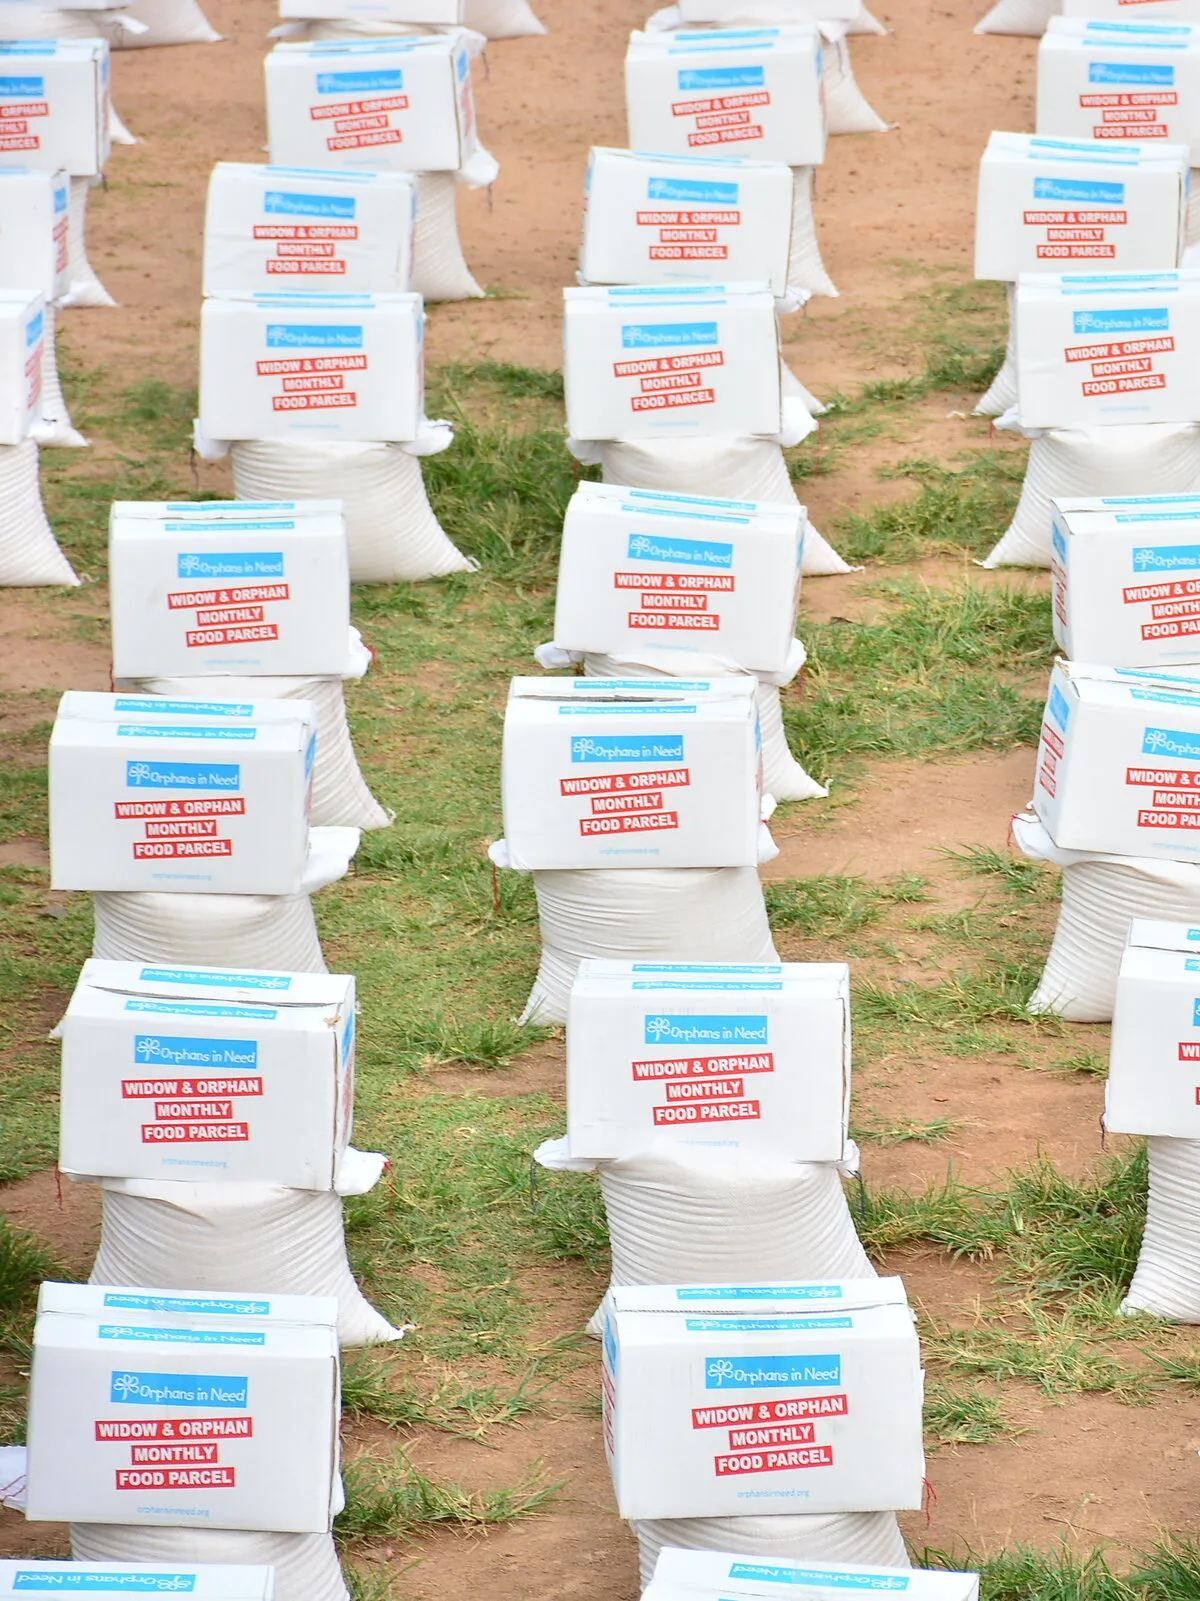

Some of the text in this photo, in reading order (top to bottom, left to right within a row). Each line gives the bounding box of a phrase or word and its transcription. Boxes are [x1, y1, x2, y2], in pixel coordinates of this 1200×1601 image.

[1066, 345, 1109, 360] WIDOW
[1122, 338, 1173, 354] ORPHAN
[258, 360, 301, 374] WIDOW
[315, 356, 365, 371] ORPHAN
[1093, 358, 1150, 376] MONTHLY
[284, 376, 342, 390] MONTHLY
[1083, 375, 1164, 394] FOOD PARCEL
[274, 393, 355, 409] FOOD PARCEL
[617, 574, 732, 590] WIDOW & ORPHAN
[643, 595, 706, 609] MONTHLY
[630, 614, 718, 628] FOOD PARCEL
[594, 745, 683, 761] Orphans in Need
[150, 772, 239, 786] Orphans in Need
[562, 770, 687, 793] WIDOW & ORPHAN
[1129, 769, 1178, 785] WIDOW
[1179, 773, 1191, 785] &
[117, 799, 242, 817] WIDOW & ORPHAN
[593, 794, 661, 812] MONTHLY
[581, 813, 676, 833] FOOD PARCEL
[1139, 812, 1178, 826] FOOD
[147, 821, 215, 836] MONTHLY
[135, 841, 230, 857] FOOD PARCEL
[670, 1026, 766, 1042] Orphans in Need
[160, 1048, 256, 1064] Orphans in Need
[635, 1055, 771, 1078] WIDOW & ORPHAN
[124, 1079, 260, 1096] WIDOW & ORPHAN
[668, 1080, 741, 1099] MONTHLY
[157, 1103, 231, 1117] MONTHLY
[655, 1102, 758, 1122] FOOD PARCEL
[143, 1125, 247, 1140] FOOD PARCEL
[733, 1366, 839, 1386] Orphans in Need
[139, 1386, 246, 1402] Orphans in Need
[695, 1397, 844, 1425] WIDOW & ORPHAN
[98, 1420, 249, 1438] WIDOW & ORPHAN
[731, 1425, 812, 1447] MONTHLY
[134, 1446, 216, 1462] MONTHLY
[717, 1448, 831, 1473] FOOD PARCEL
[118, 1470, 233, 1487] FOOD PARCEL
